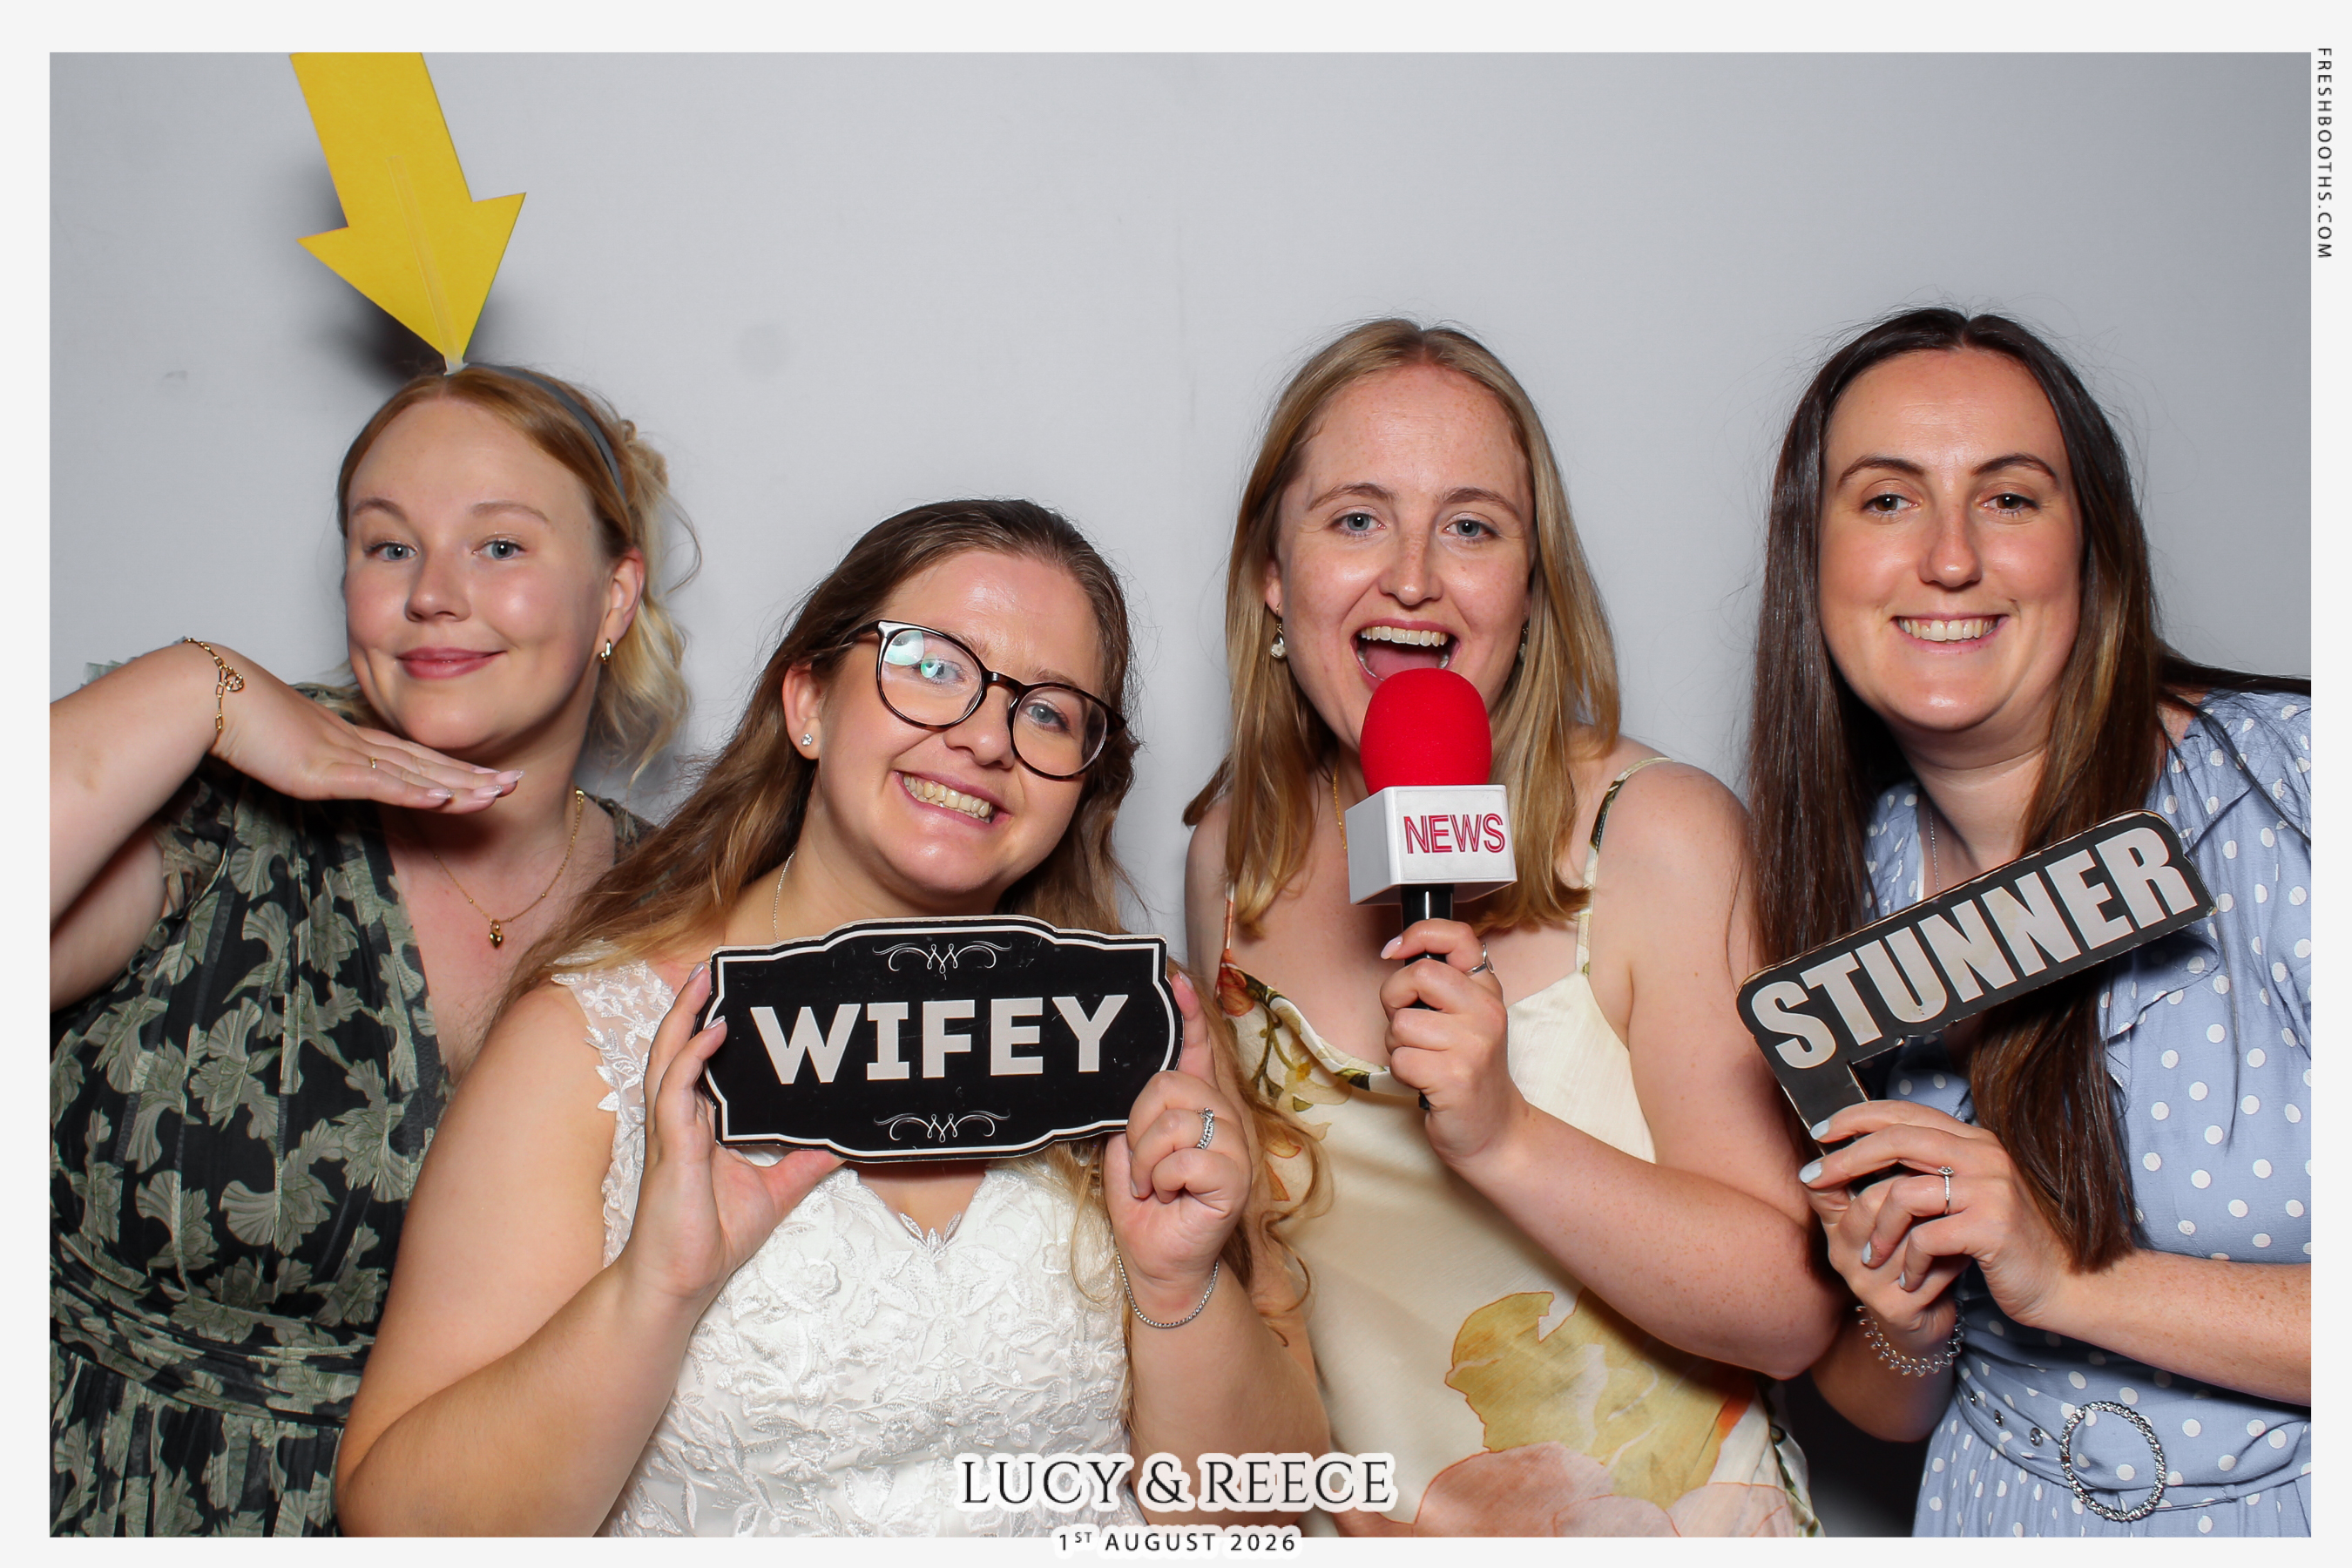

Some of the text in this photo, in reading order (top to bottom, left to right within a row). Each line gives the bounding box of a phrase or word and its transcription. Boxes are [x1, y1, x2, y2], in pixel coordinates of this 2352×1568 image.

[1403, 813, 1506, 854] NEWS
[1751, 826, 2199, 1070] STUNNER
[749, 994, 1129, 1085] WIFEY
